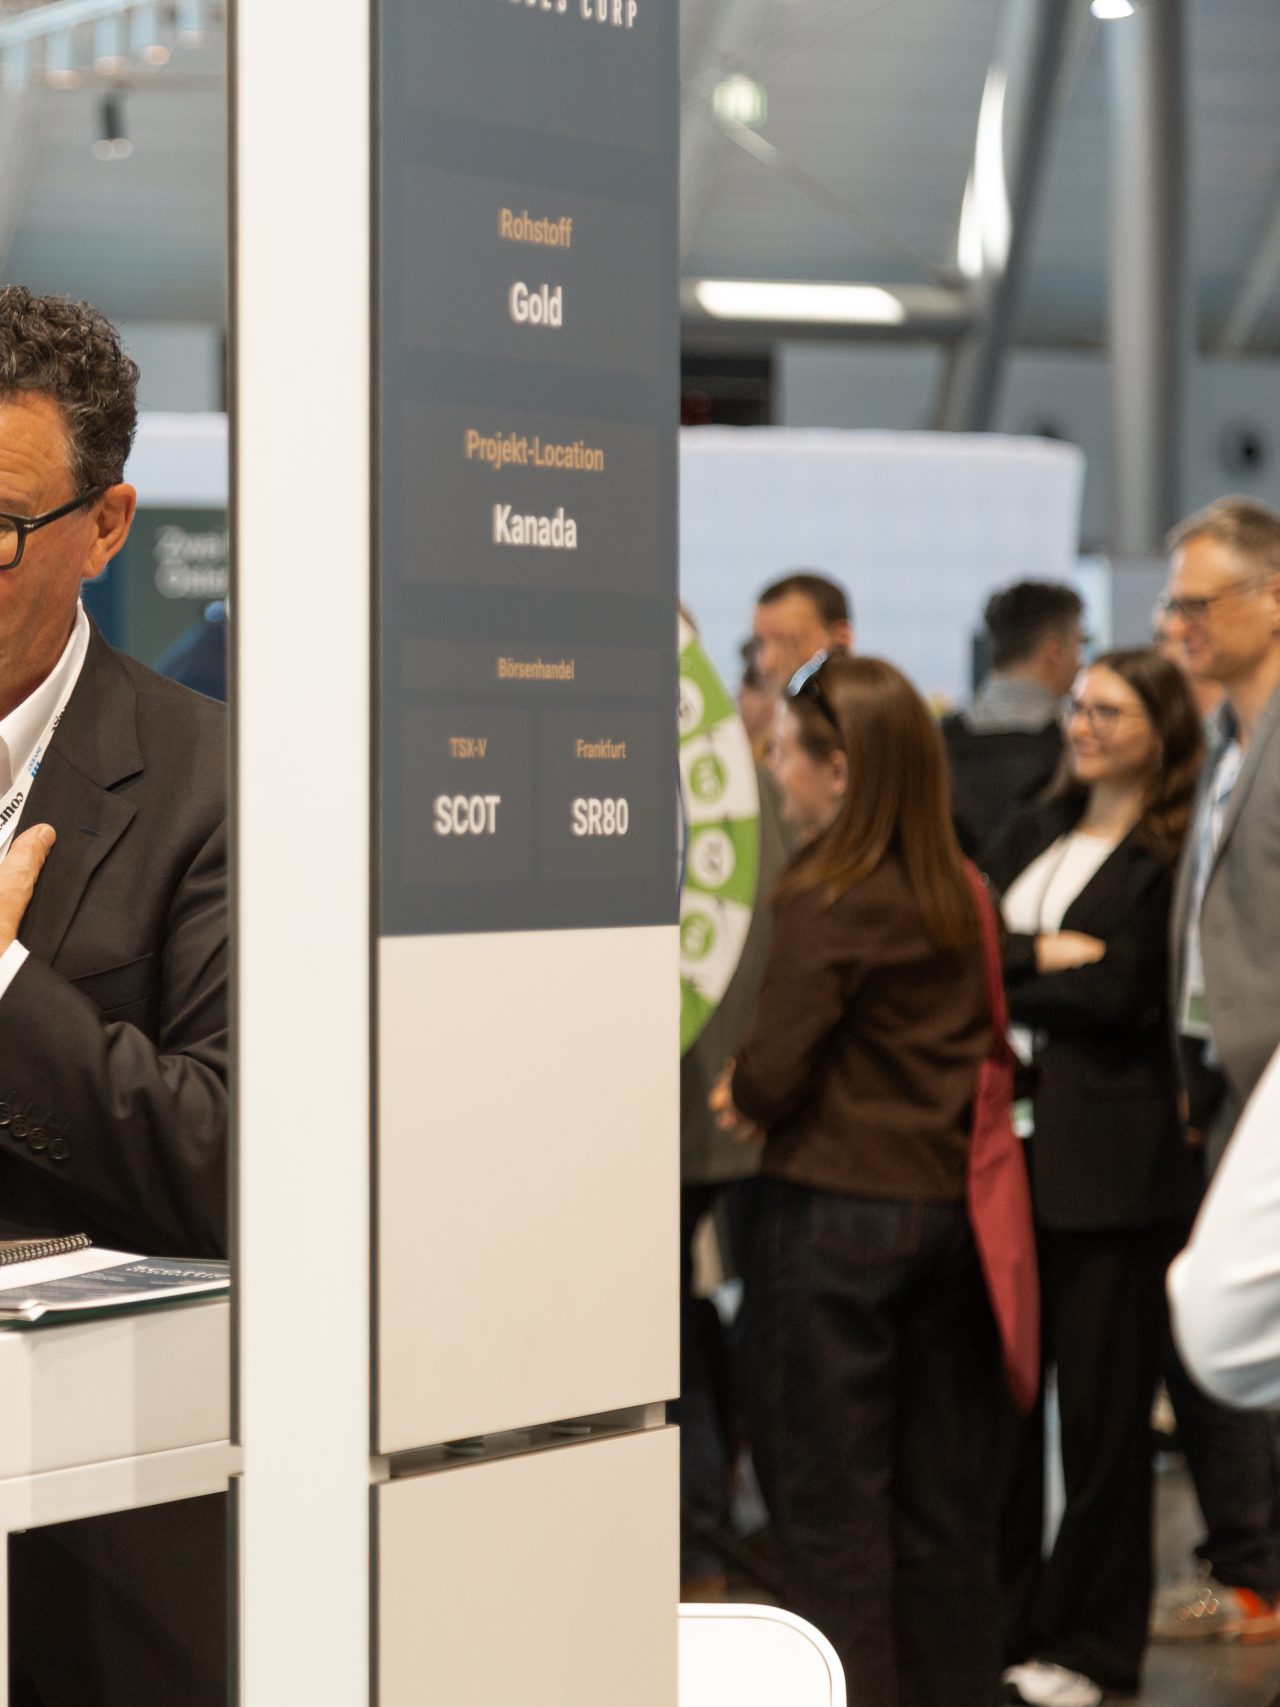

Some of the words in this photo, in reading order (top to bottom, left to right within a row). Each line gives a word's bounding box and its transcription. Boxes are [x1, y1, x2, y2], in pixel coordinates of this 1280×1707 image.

[581, 0, 638, 28] CORP
[498, 207, 573, 248] Rohstoff
[509, 281, 563, 328] Gold
[464, 428, 605, 472] Projekt-Location
[493, 503, 578, 549] Kanada
[497, 656, 576, 682] Börsenhandel
[449, 736, 487, 759] TSX-V
[576, 738, 627, 760] Frankfurt
[434, 794, 501, 836] SCOT
[572, 797, 629, 837] SR80
